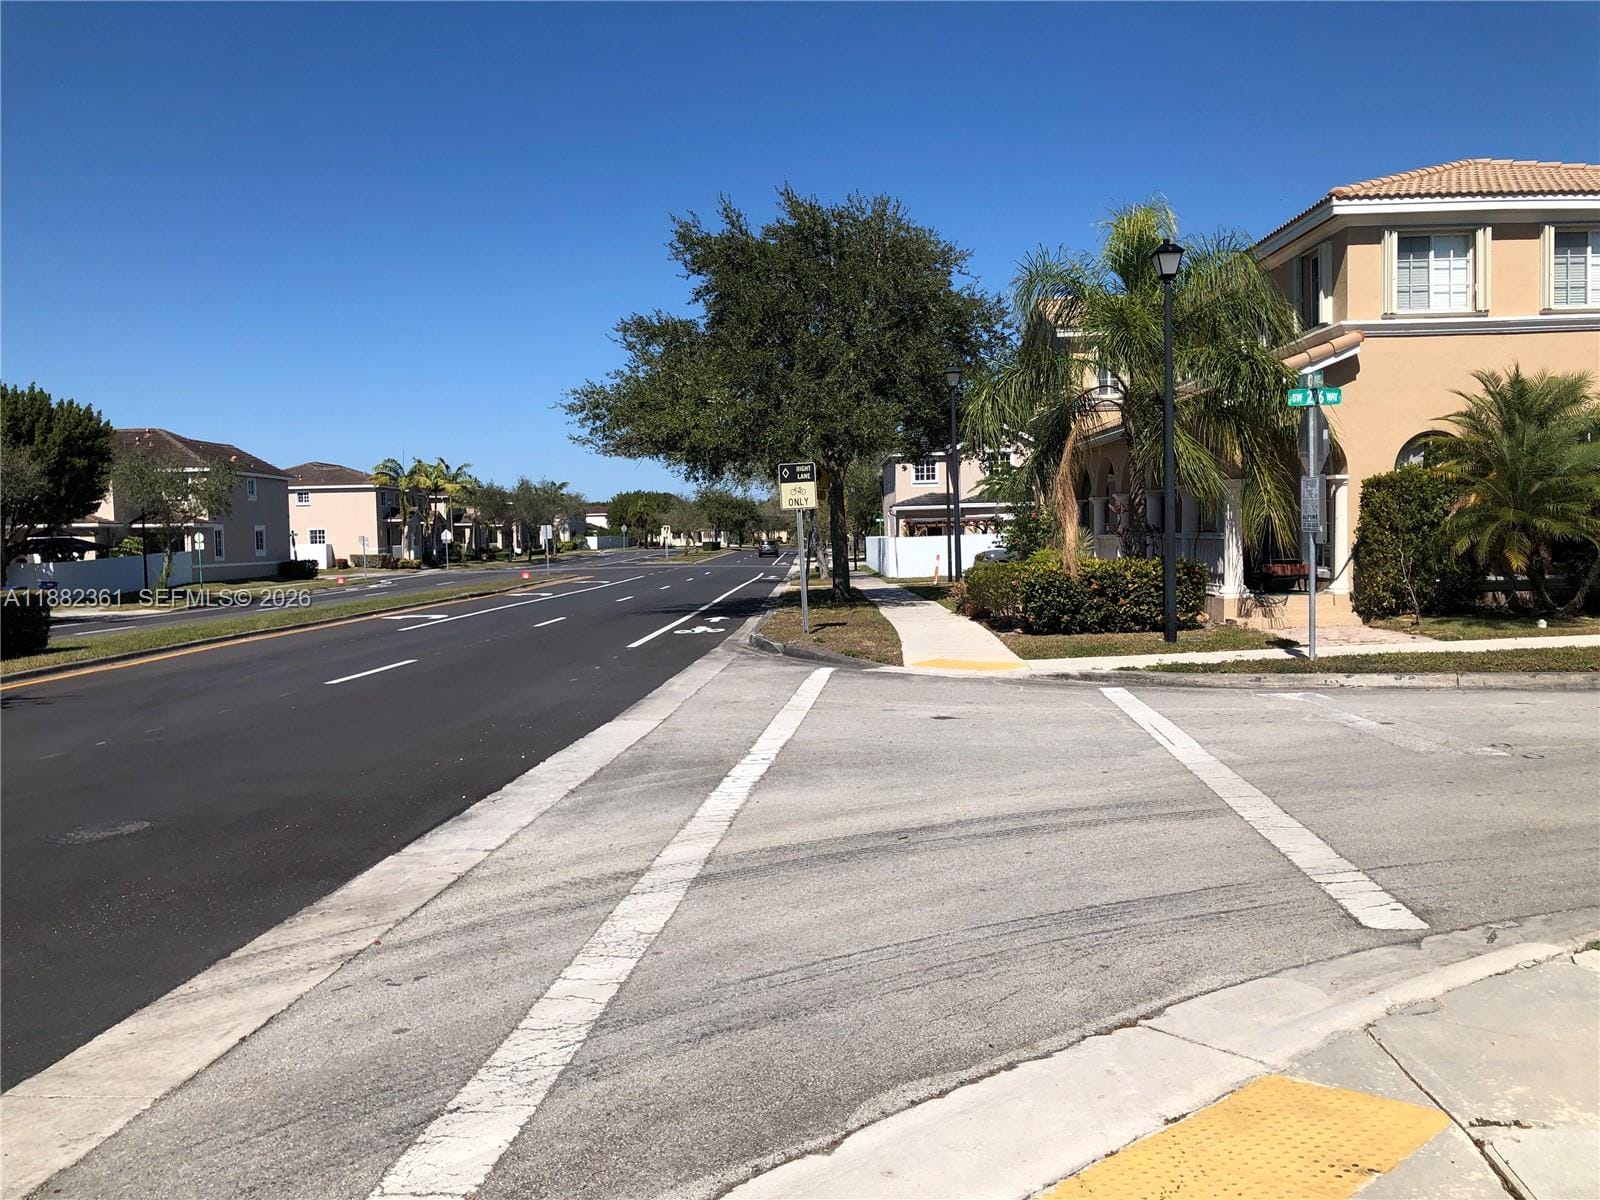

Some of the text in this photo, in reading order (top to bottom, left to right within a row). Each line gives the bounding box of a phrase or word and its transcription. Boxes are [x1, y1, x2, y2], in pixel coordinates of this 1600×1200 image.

[1291, 390, 1339, 405] SW 26 WAY
[797, 472, 811, 480] LANE
[788, 497, 809, 507] ONLY
